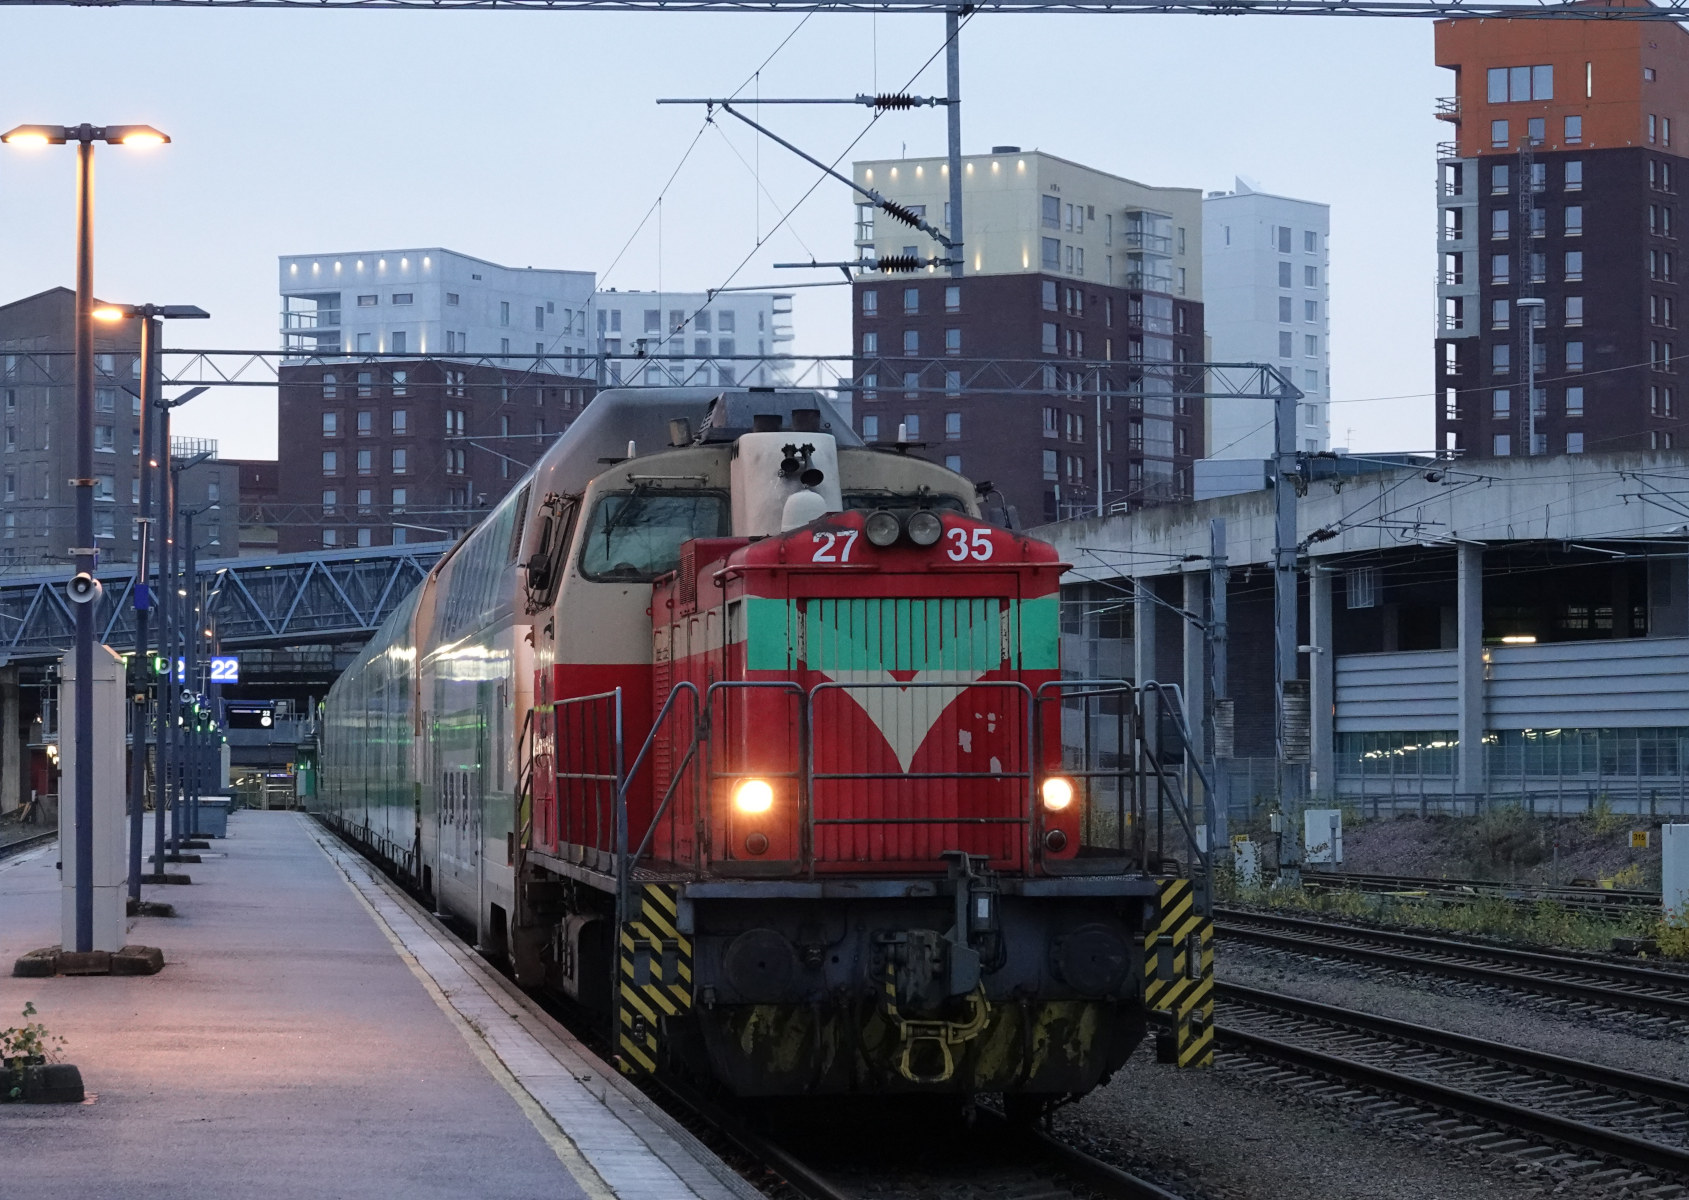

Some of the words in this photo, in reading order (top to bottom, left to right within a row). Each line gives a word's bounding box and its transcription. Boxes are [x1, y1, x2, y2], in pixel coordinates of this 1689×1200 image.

[812, 530, 858, 562] 27
[947, 528, 993, 561] 35
[211, 660, 238, 679] 22
